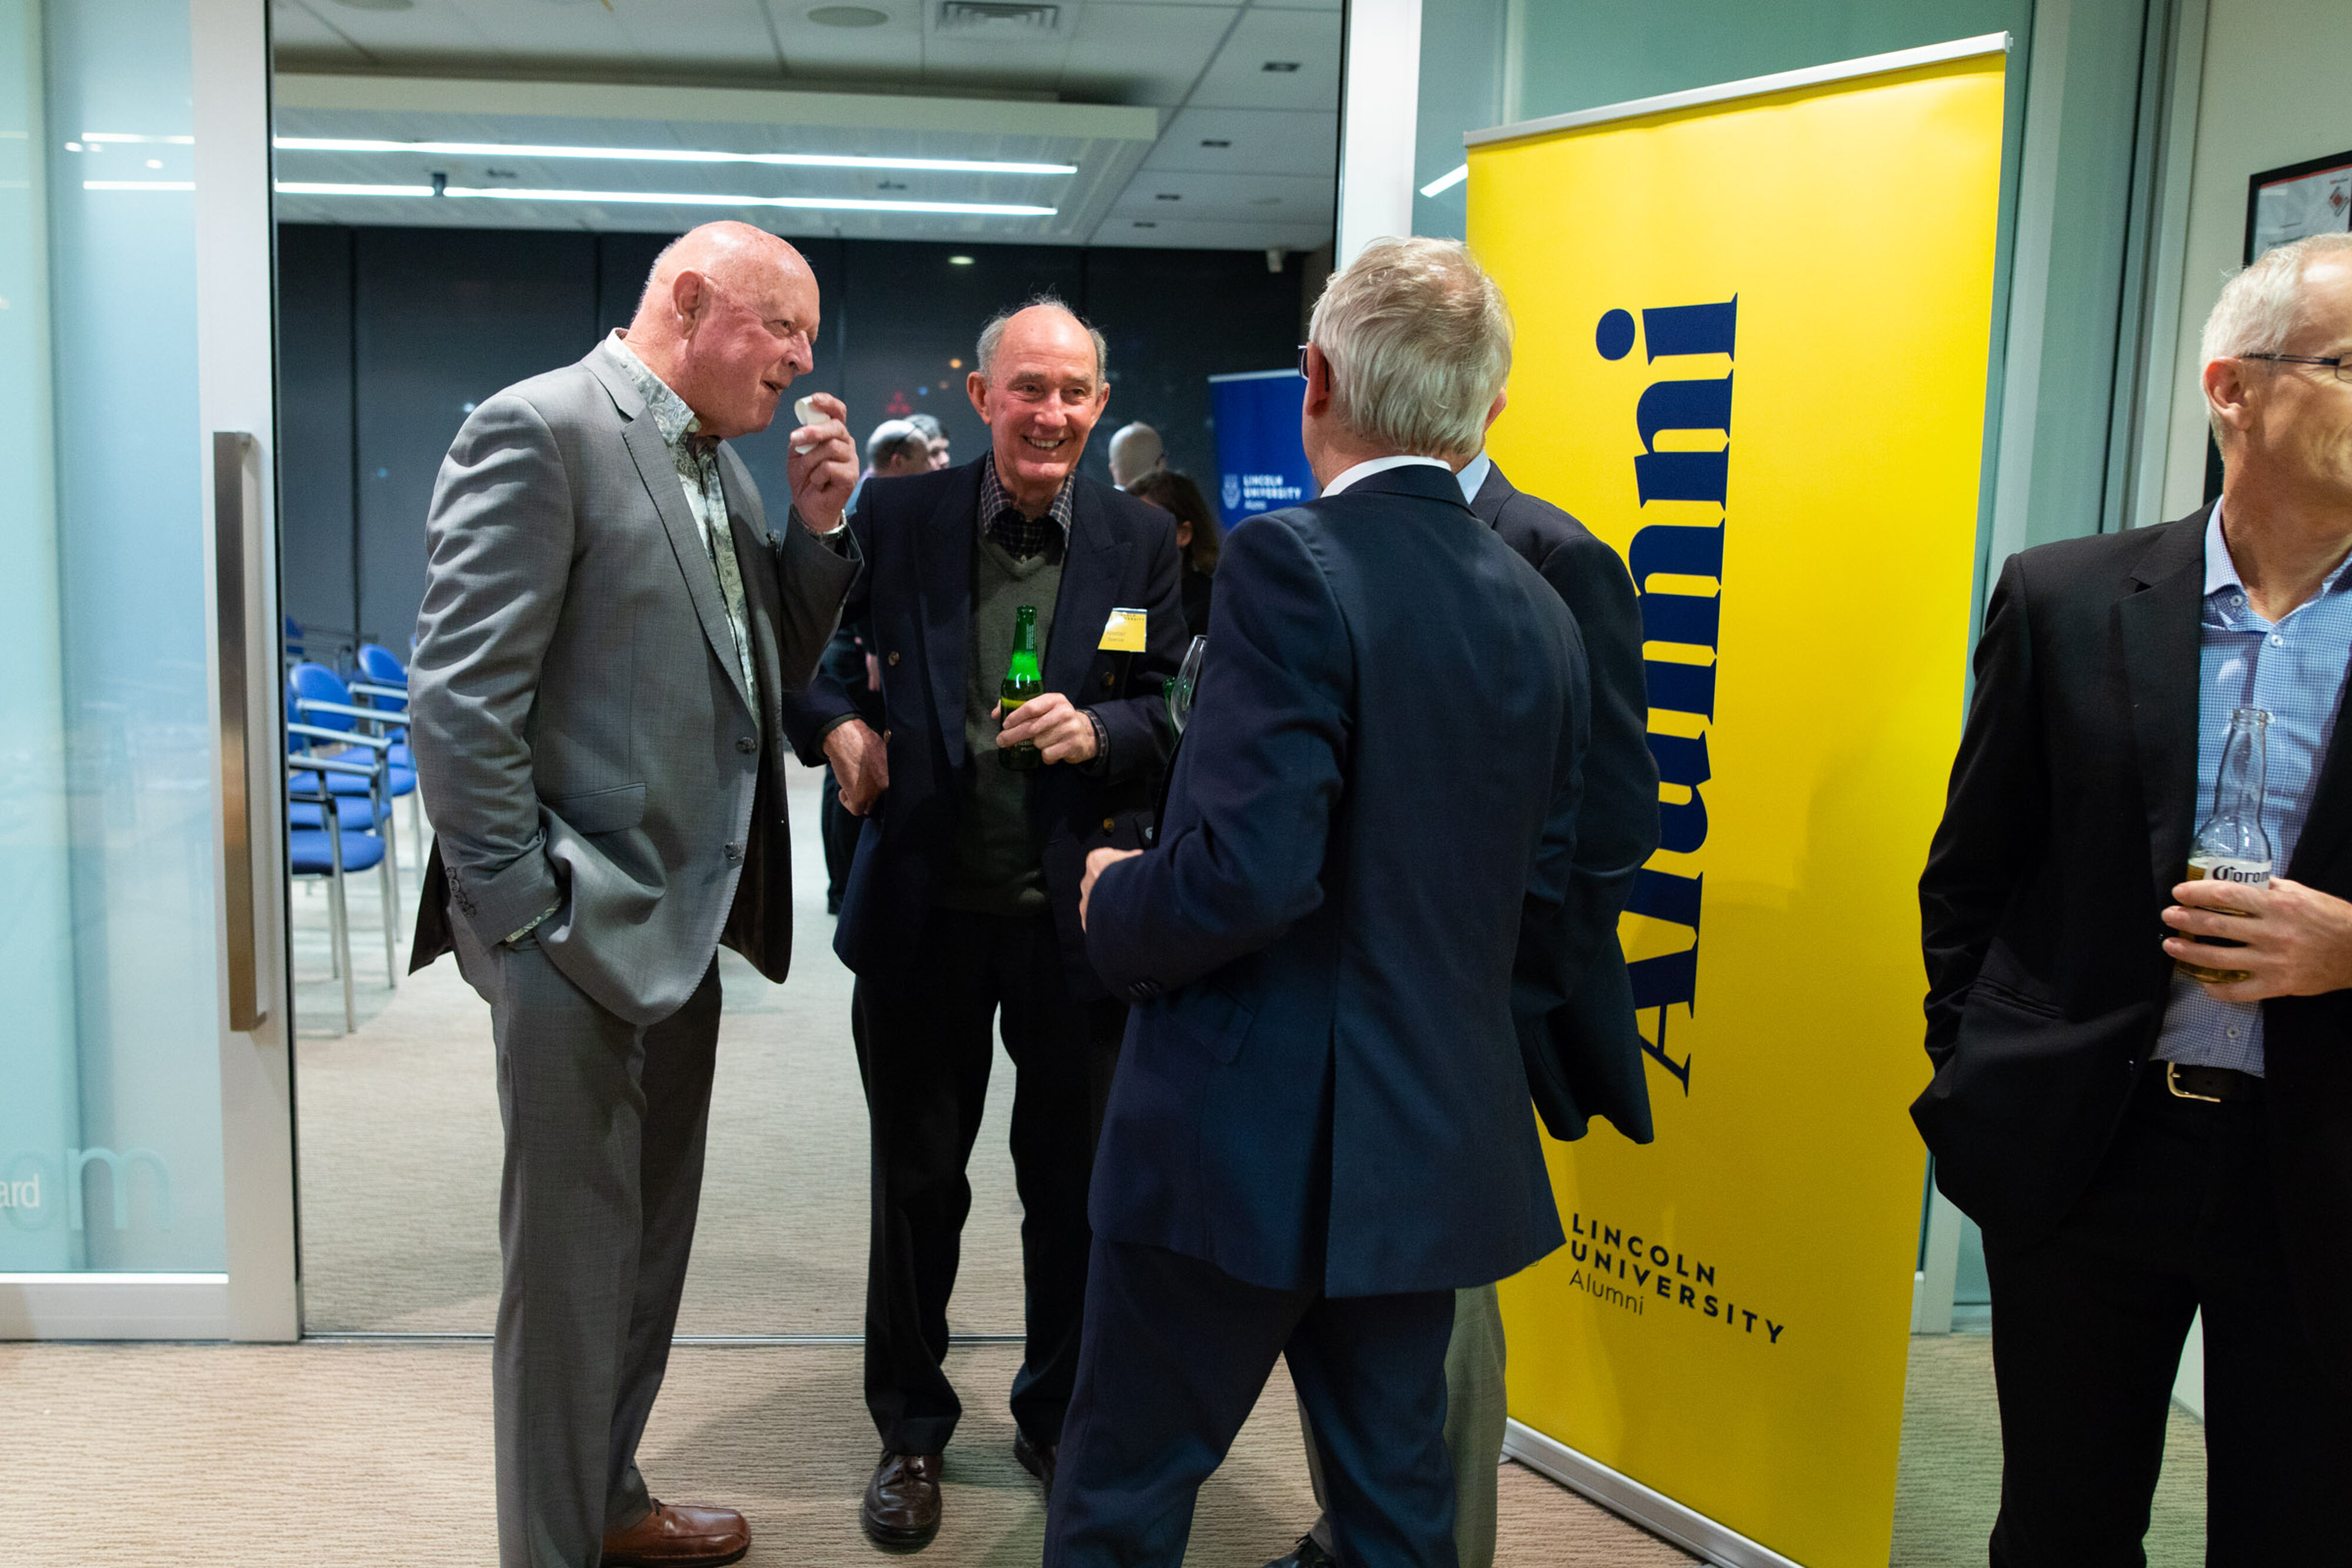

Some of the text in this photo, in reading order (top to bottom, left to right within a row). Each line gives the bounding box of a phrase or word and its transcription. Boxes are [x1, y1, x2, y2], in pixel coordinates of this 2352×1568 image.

[1573, 1213, 1715, 1287] LINCOLN
[1569, 1269, 1644, 1316] Alumni
[1571, 1239, 1784, 1344] UNIVERSITY
